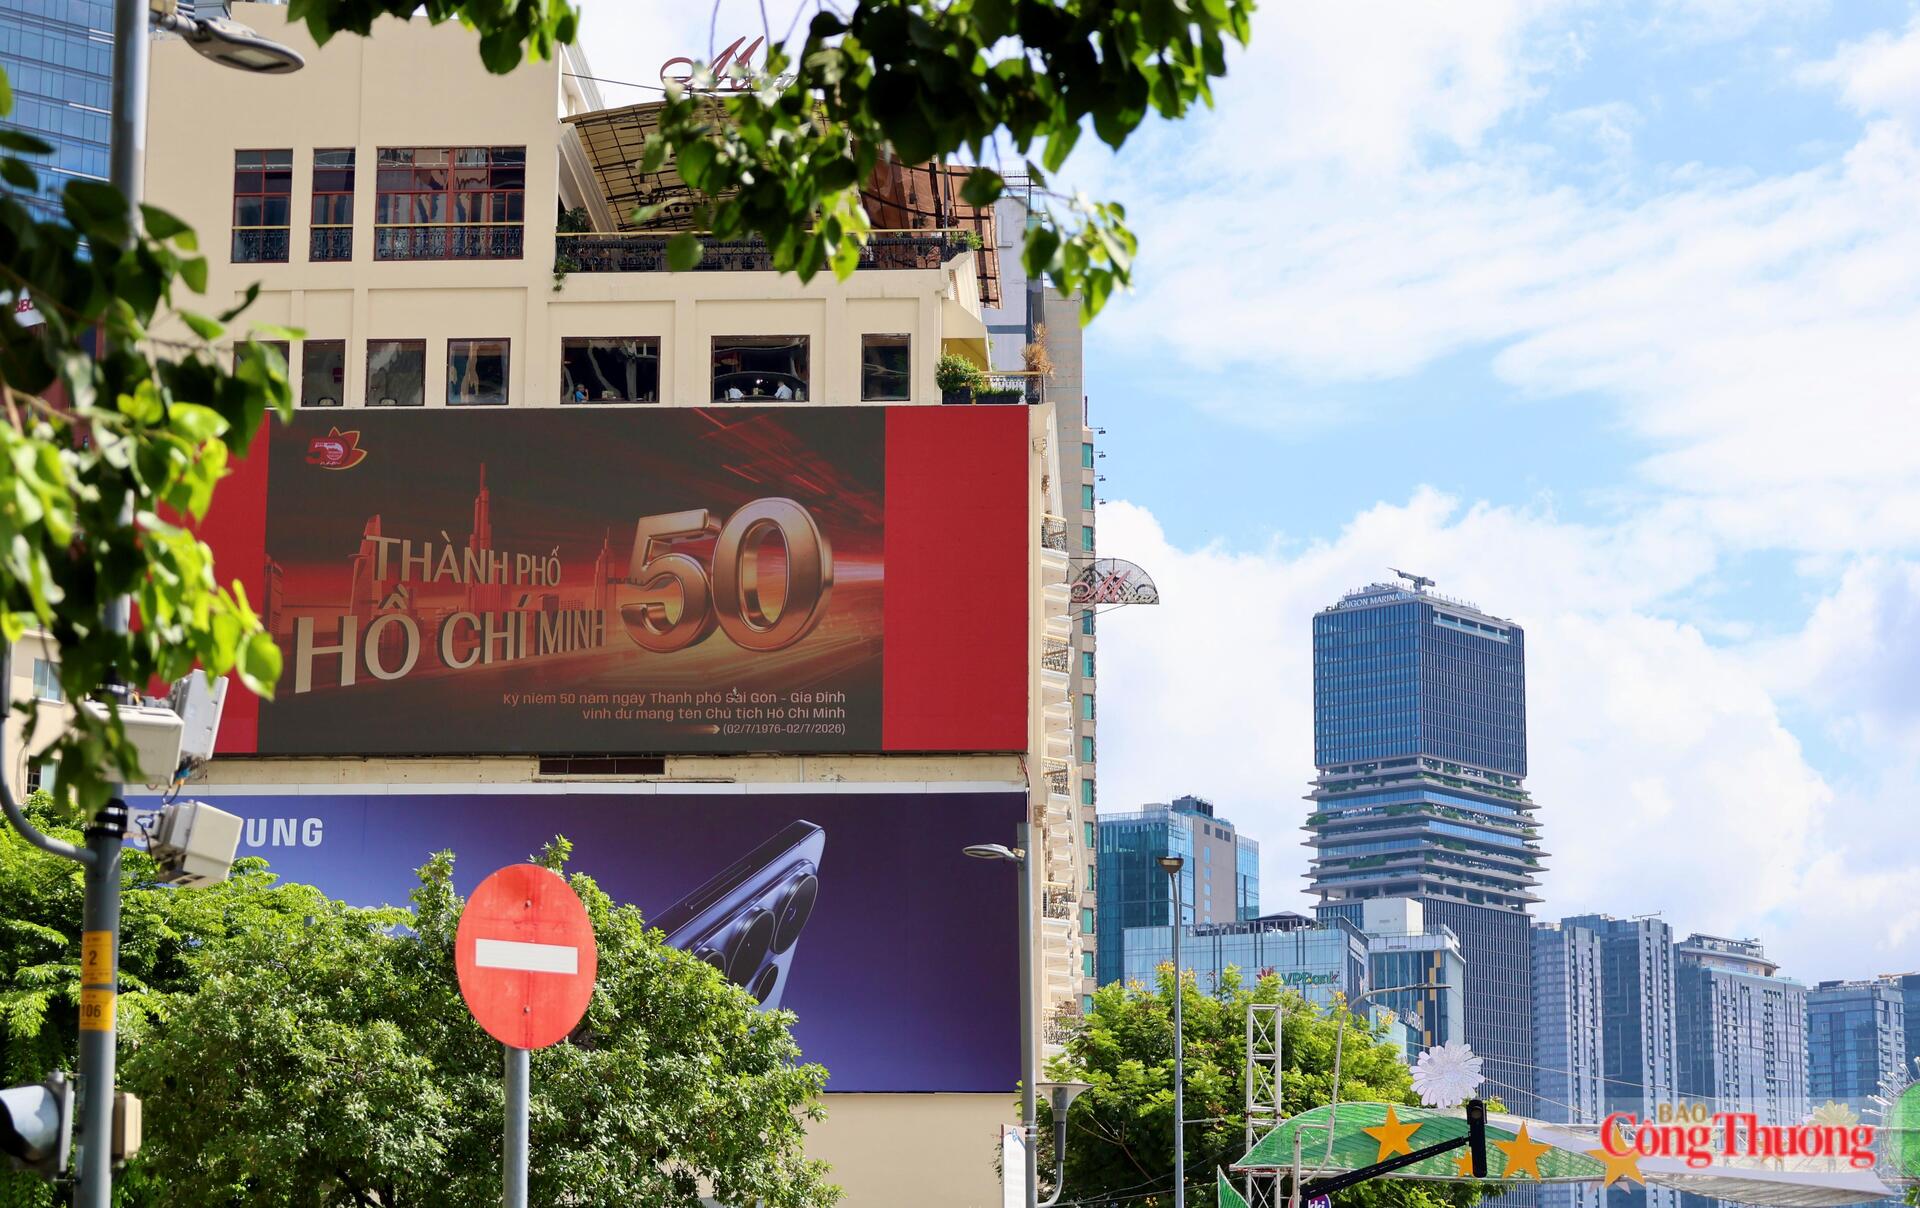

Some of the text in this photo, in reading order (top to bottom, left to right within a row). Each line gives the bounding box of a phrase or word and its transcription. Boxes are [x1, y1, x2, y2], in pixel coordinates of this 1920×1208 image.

[366, 530, 561, 587] THÀNH PHỐ
[621, 497, 833, 653] 50
[1339, 598, 1369, 609] SAIGON
[1370, 593, 1400, 605] MARINA
[293, 584, 607, 693] HỒ CHÍ MINH
[559, 693, 576, 704] 50
[790, 691, 812, 703] Gia
[635, 708, 674, 721] mang
[813, 707, 846, 719] Minh
[723, 723, 846, 735] (02/7/1976-02/7/2026)
[89, 950, 97, 965] 2
[1281, 971, 1340, 986] VPBank
